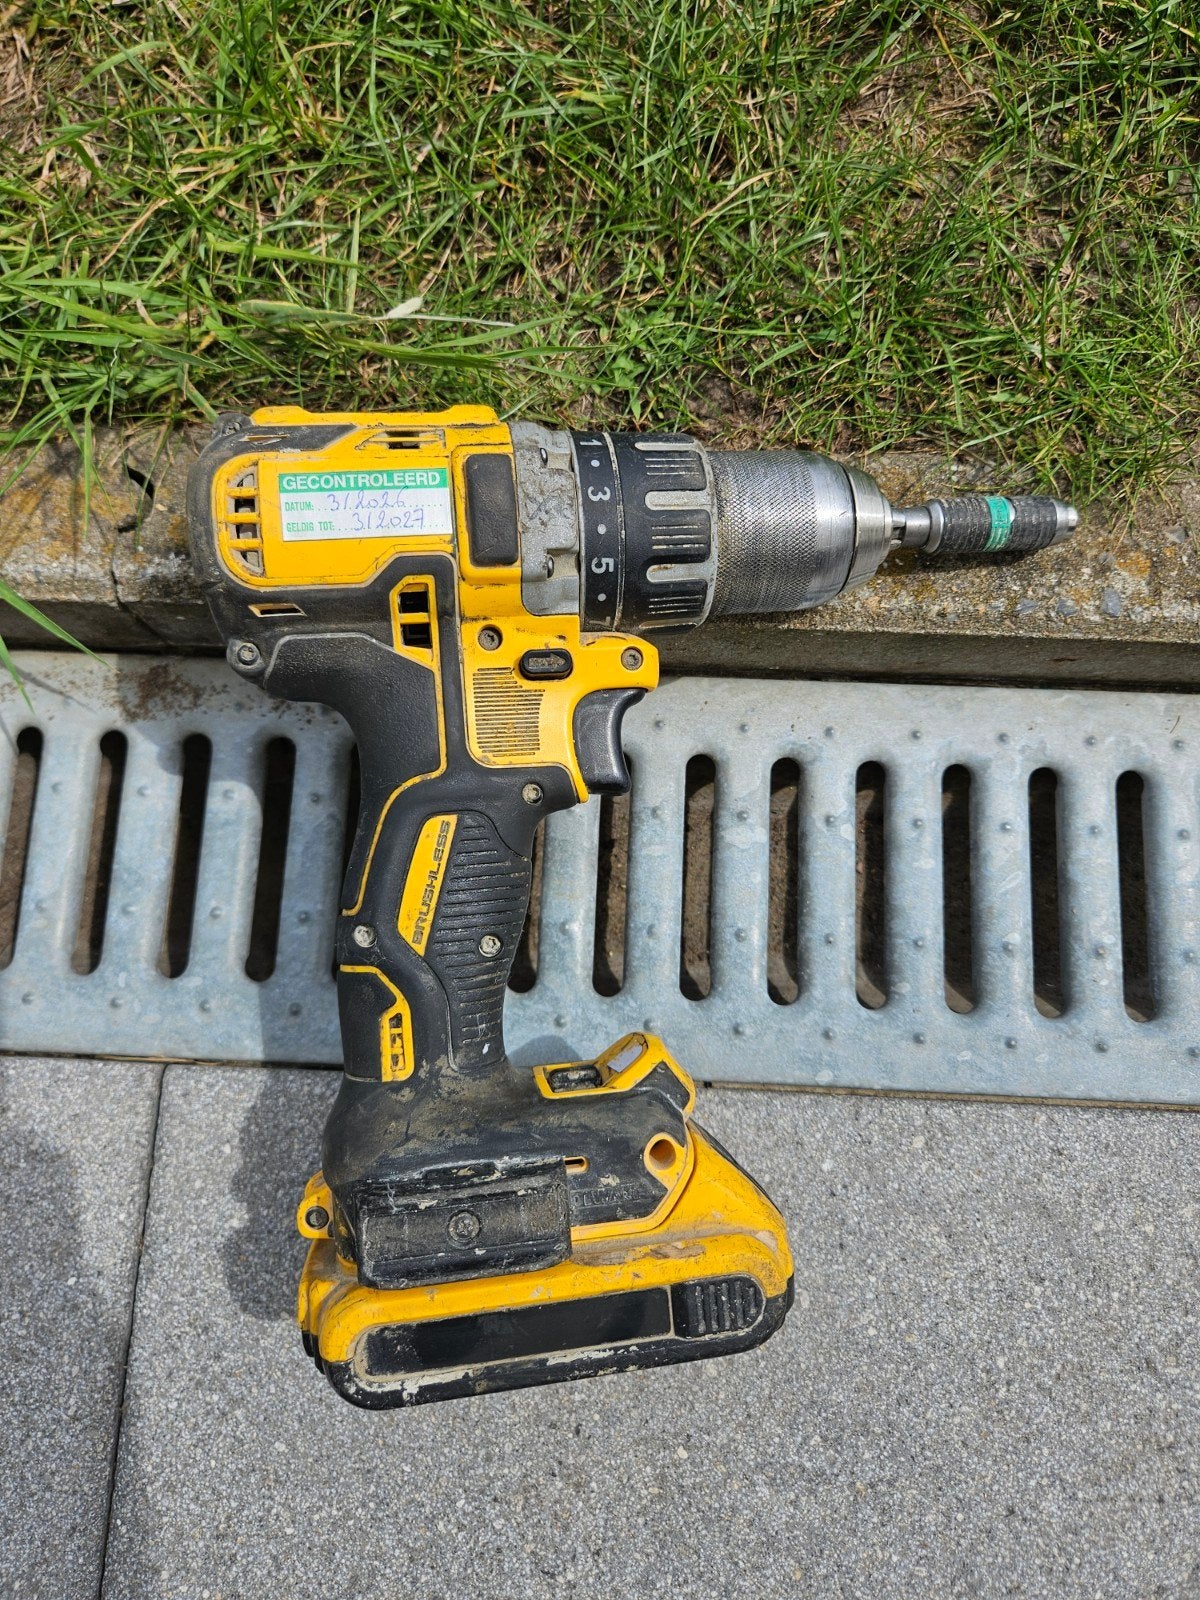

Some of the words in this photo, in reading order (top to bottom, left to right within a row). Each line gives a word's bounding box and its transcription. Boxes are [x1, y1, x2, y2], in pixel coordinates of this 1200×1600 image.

[579, 438, 603, 447] 1
[282, 471, 441, 490] GECONTROLEERD
[587, 485, 611, 502] 3
[284, 501, 315, 512] DATUM:
[286, 521, 314, 533] GELDIG
[319, 520, 335, 532] TOT:
[591, 556, 615, 574] 5
[411, 820, 451, 945] BRUSHLESS
